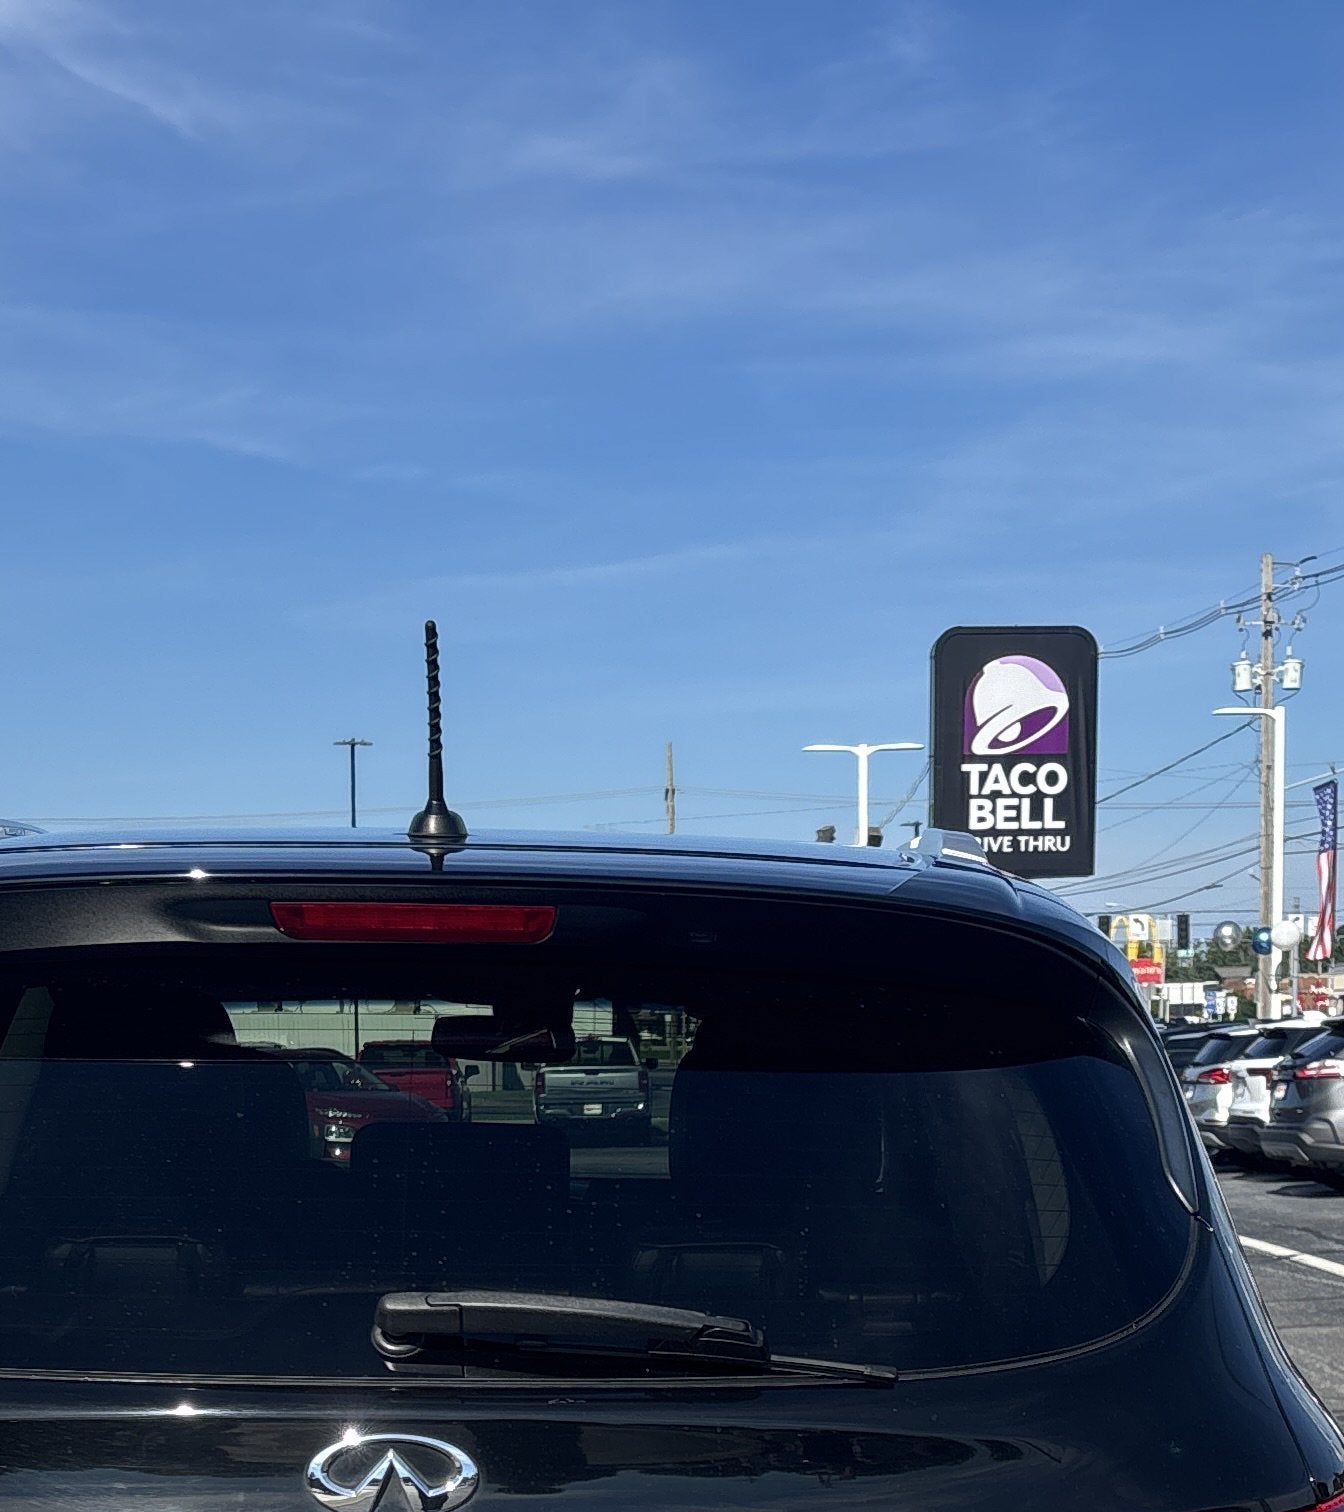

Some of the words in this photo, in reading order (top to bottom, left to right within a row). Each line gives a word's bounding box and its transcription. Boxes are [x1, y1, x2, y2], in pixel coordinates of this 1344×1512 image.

[960, 762, 1068, 796] TACO
[968, 798, 1066, 830] BELL
[973, 835, 1013, 853] IVE
[1016, 835, 1071, 853] THRU
